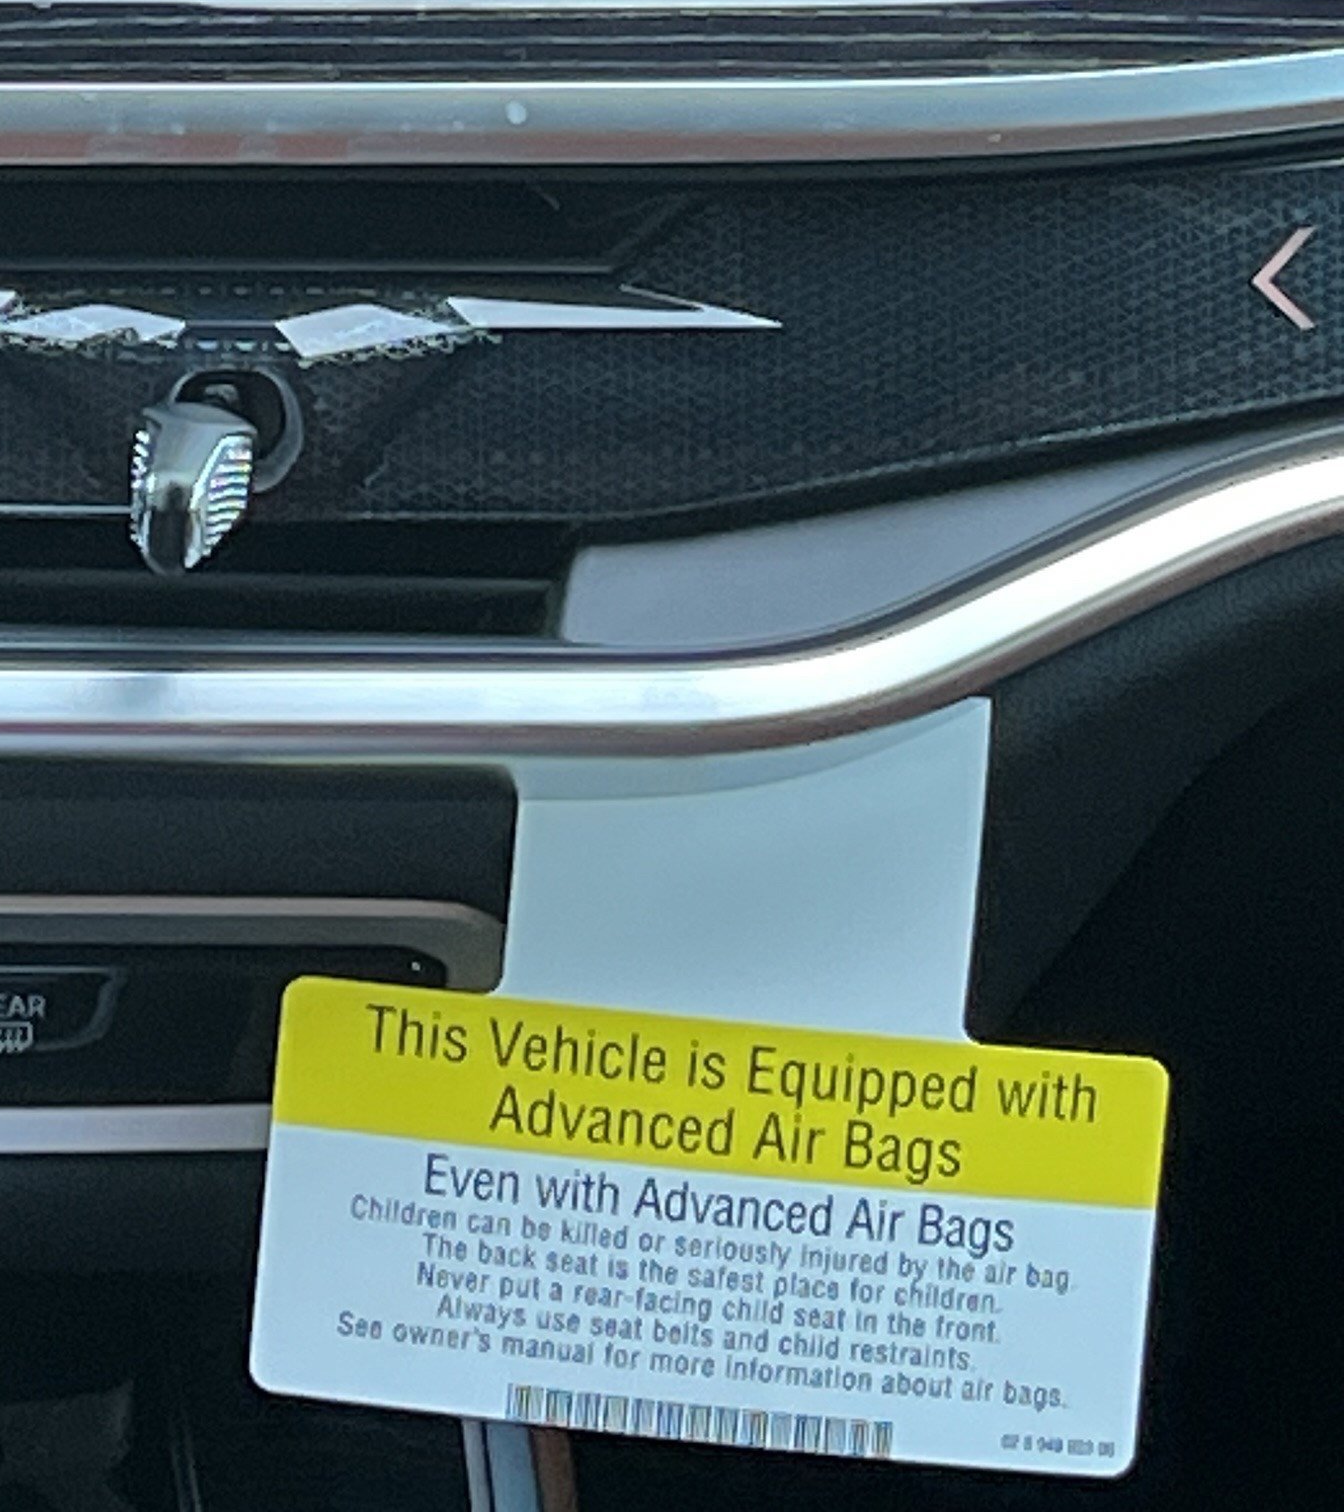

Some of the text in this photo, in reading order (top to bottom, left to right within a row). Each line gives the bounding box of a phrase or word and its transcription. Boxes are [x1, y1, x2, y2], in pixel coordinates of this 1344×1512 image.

[366, 1003, 1097, 1123] This Vehicle is Equipped with
[489, 1085, 962, 1185] Advanced Air Bags
[350, 1194, 457, 1230] Children
[468, 1214, 511, 1235] can
[521, 1215, 551, 1241] be
[562, 1219, 629, 1250] killed
[638, 1232, 665, 1253] or
[674, 1235, 792, 1270] seriously
[801, 1244, 888, 1274] injured
[899, 1252, 928, 1283] by
[938, 1257, 975, 1282] the
[985, 1260, 1016, 1285] air
[424, 1153, 1014, 1260] Even with Advanced Air Bags
[417, 1261, 1000, 1344] Never put a rear-facing child seat in the front.
[423, 1232, 1003, 1314] The back seat is the safest place for children.
[337, 1310, 383, 1338] See
[502, 1335, 594, 1365] manual
[605, 1341, 640, 1369] for
[649, 1352, 715, 1378] more
[725, 1354, 872, 1392] information
[881, 1373, 952, 1399] about
[962, 1380, 994, 1402] air
[1003, 1380, 1069, 1412] bags.
[436, 1293, 526, 1329] Always
[536, 1311, 581, 1334] use
[590, 1316, 643, 1339] seat
[653, 1319, 713, 1347] belts
[723, 1328, 769, 1353] and
[778, 1332, 839, 1360] child
